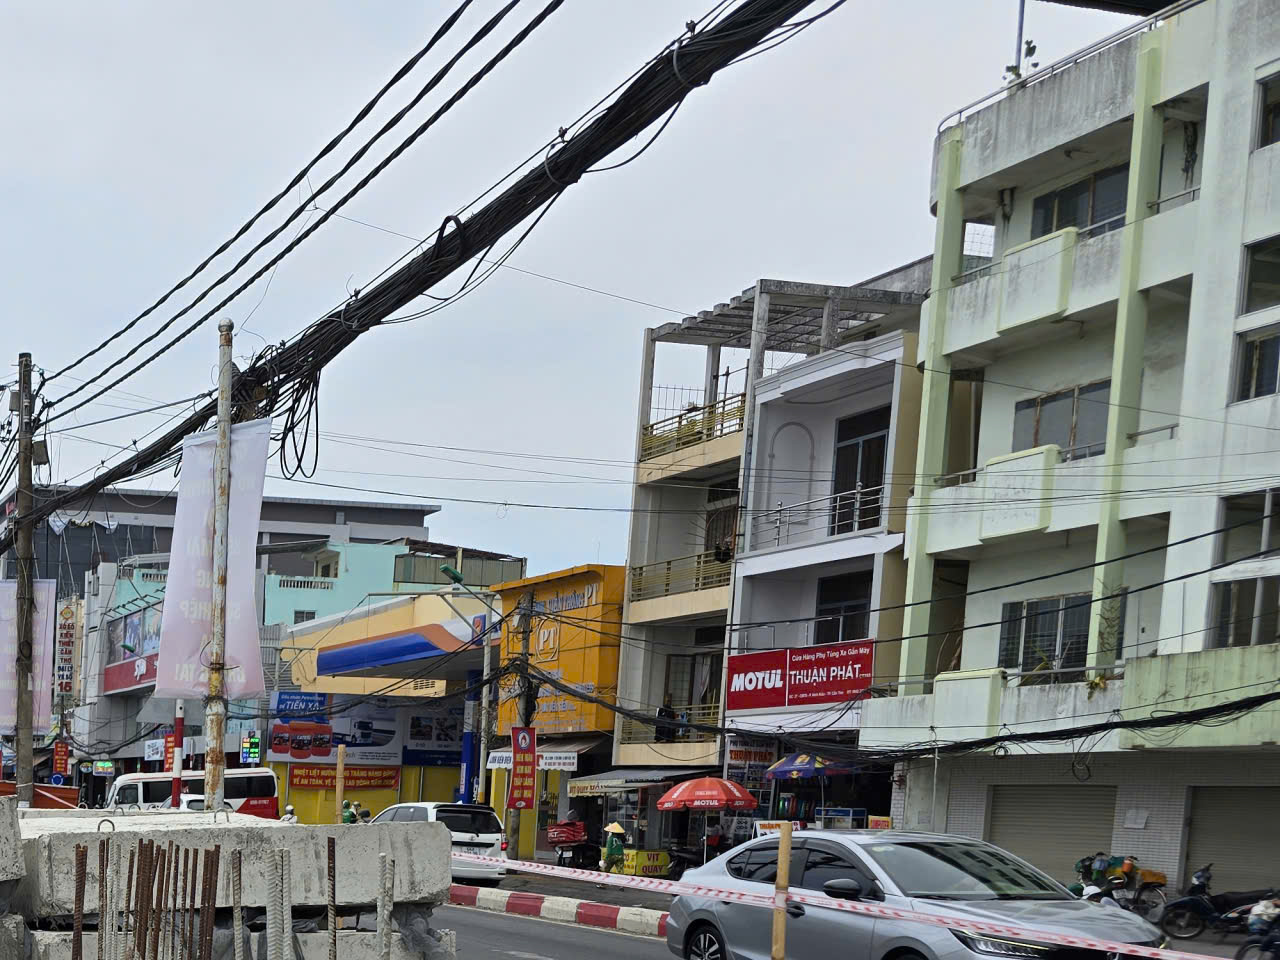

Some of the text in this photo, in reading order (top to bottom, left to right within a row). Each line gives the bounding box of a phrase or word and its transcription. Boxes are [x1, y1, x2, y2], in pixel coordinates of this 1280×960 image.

[791, 654, 802, 662] Cửa
[803, 653, 815, 662] Hàng
[859, 647, 870, 655] Máy
[730, 669, 784, 692] MOTUL
[789, 661, 861, 686] THUẬN PHÁT
[58, 681, 72, 692] 15
[642, 865, 664, 875] QUAY
